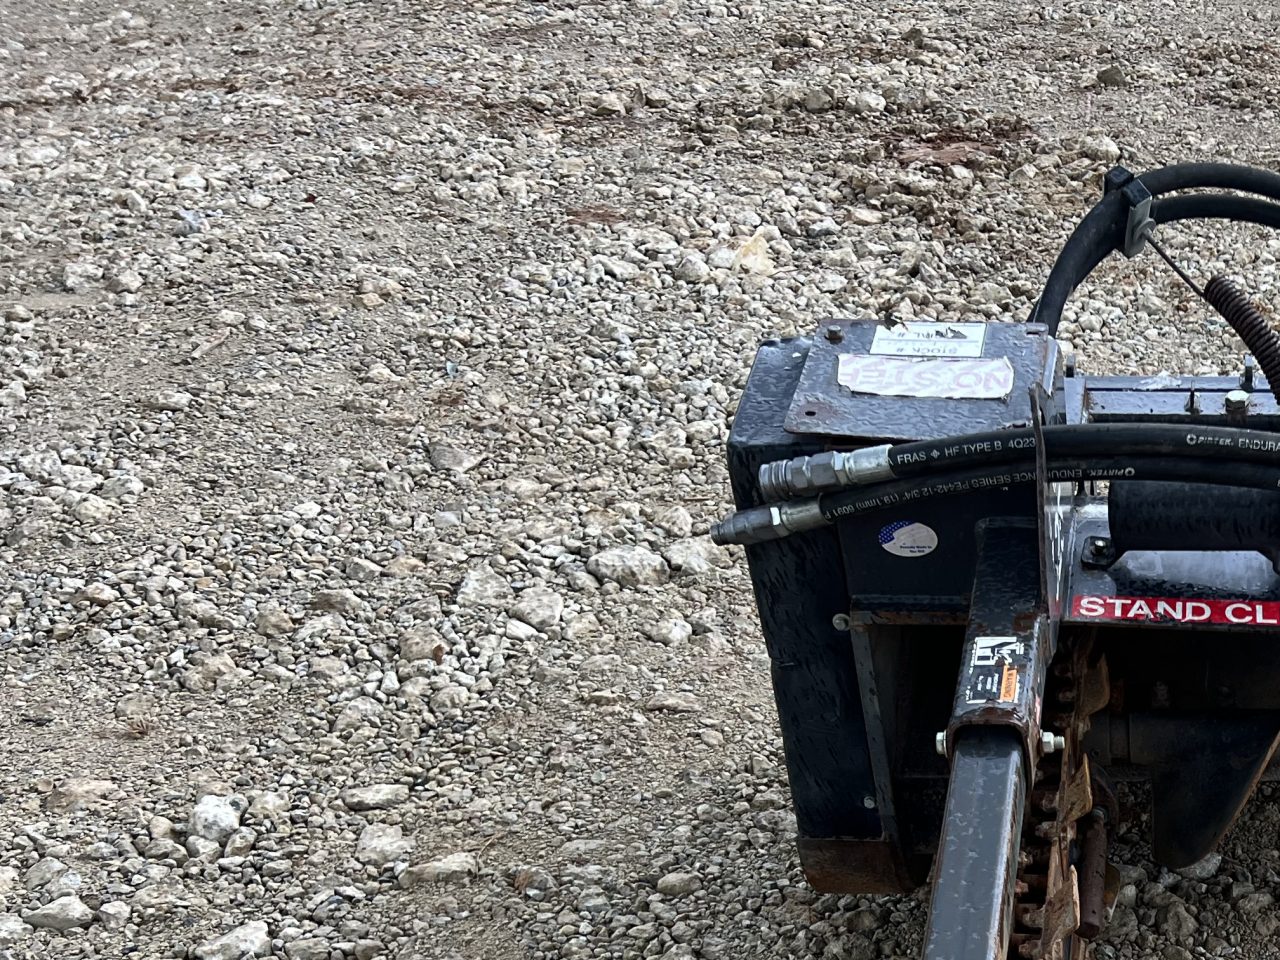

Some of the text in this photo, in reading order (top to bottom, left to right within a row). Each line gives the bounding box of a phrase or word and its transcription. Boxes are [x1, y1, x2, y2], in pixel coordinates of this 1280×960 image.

[952, 370, 1010, 389] NO
[896, 451, 927, 465] FRAS
[944, 446, 960, 457] HF
[962, 442, 991, 455] TYPE
[994, 440, 1002, 450] B
[1008, 437, 1036, 449] 4Q23
[922, 480, 970, 496] PE442-12
[971, 474, 1011, 488] SERIES
[832, 504, 855, 517] 6091
[1079, 596, 1212, 623] STAND
